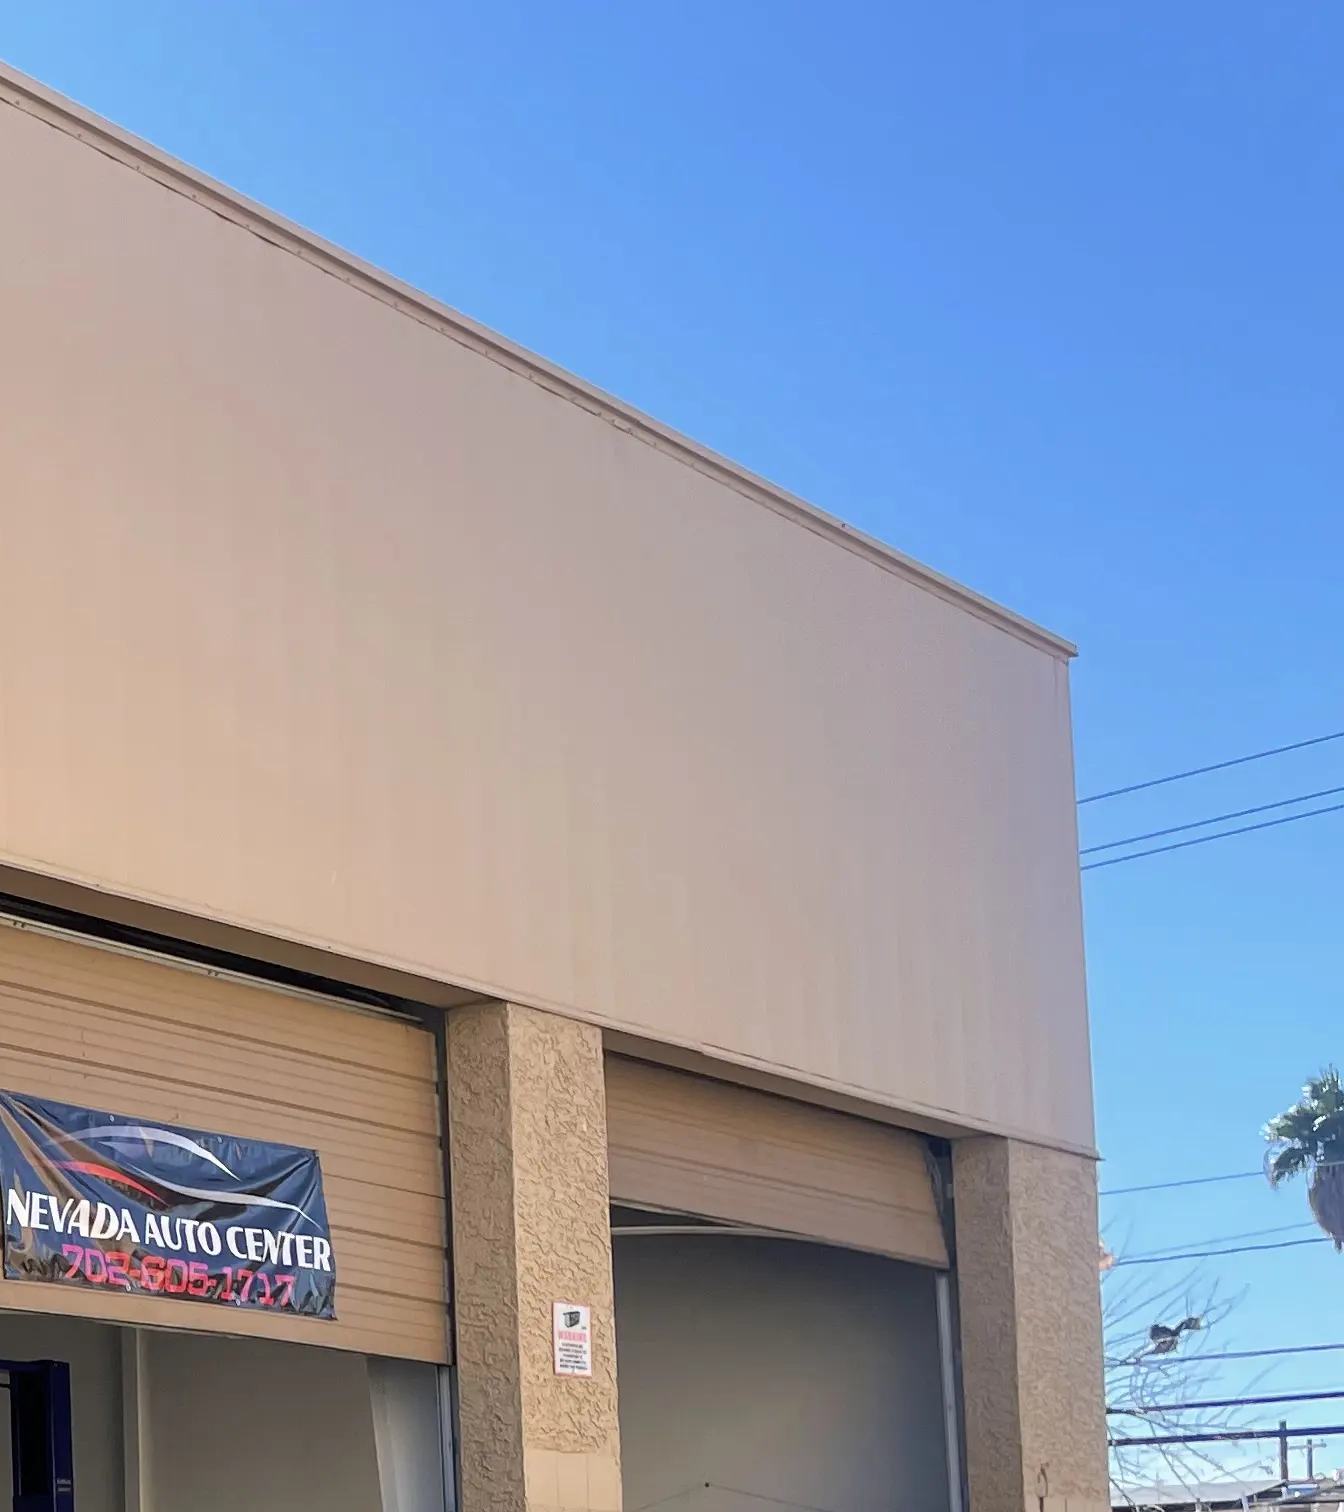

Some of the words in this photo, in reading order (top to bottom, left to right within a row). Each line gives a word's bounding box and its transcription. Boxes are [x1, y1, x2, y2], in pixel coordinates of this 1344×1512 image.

[7, 1188, 140, 1244] NEVADA
[144, 1213, 223, 1256] AUTO
[226, 1226, 331, 1272] CENTER
[62, 1244, 295, 1306] 702-605-1717
